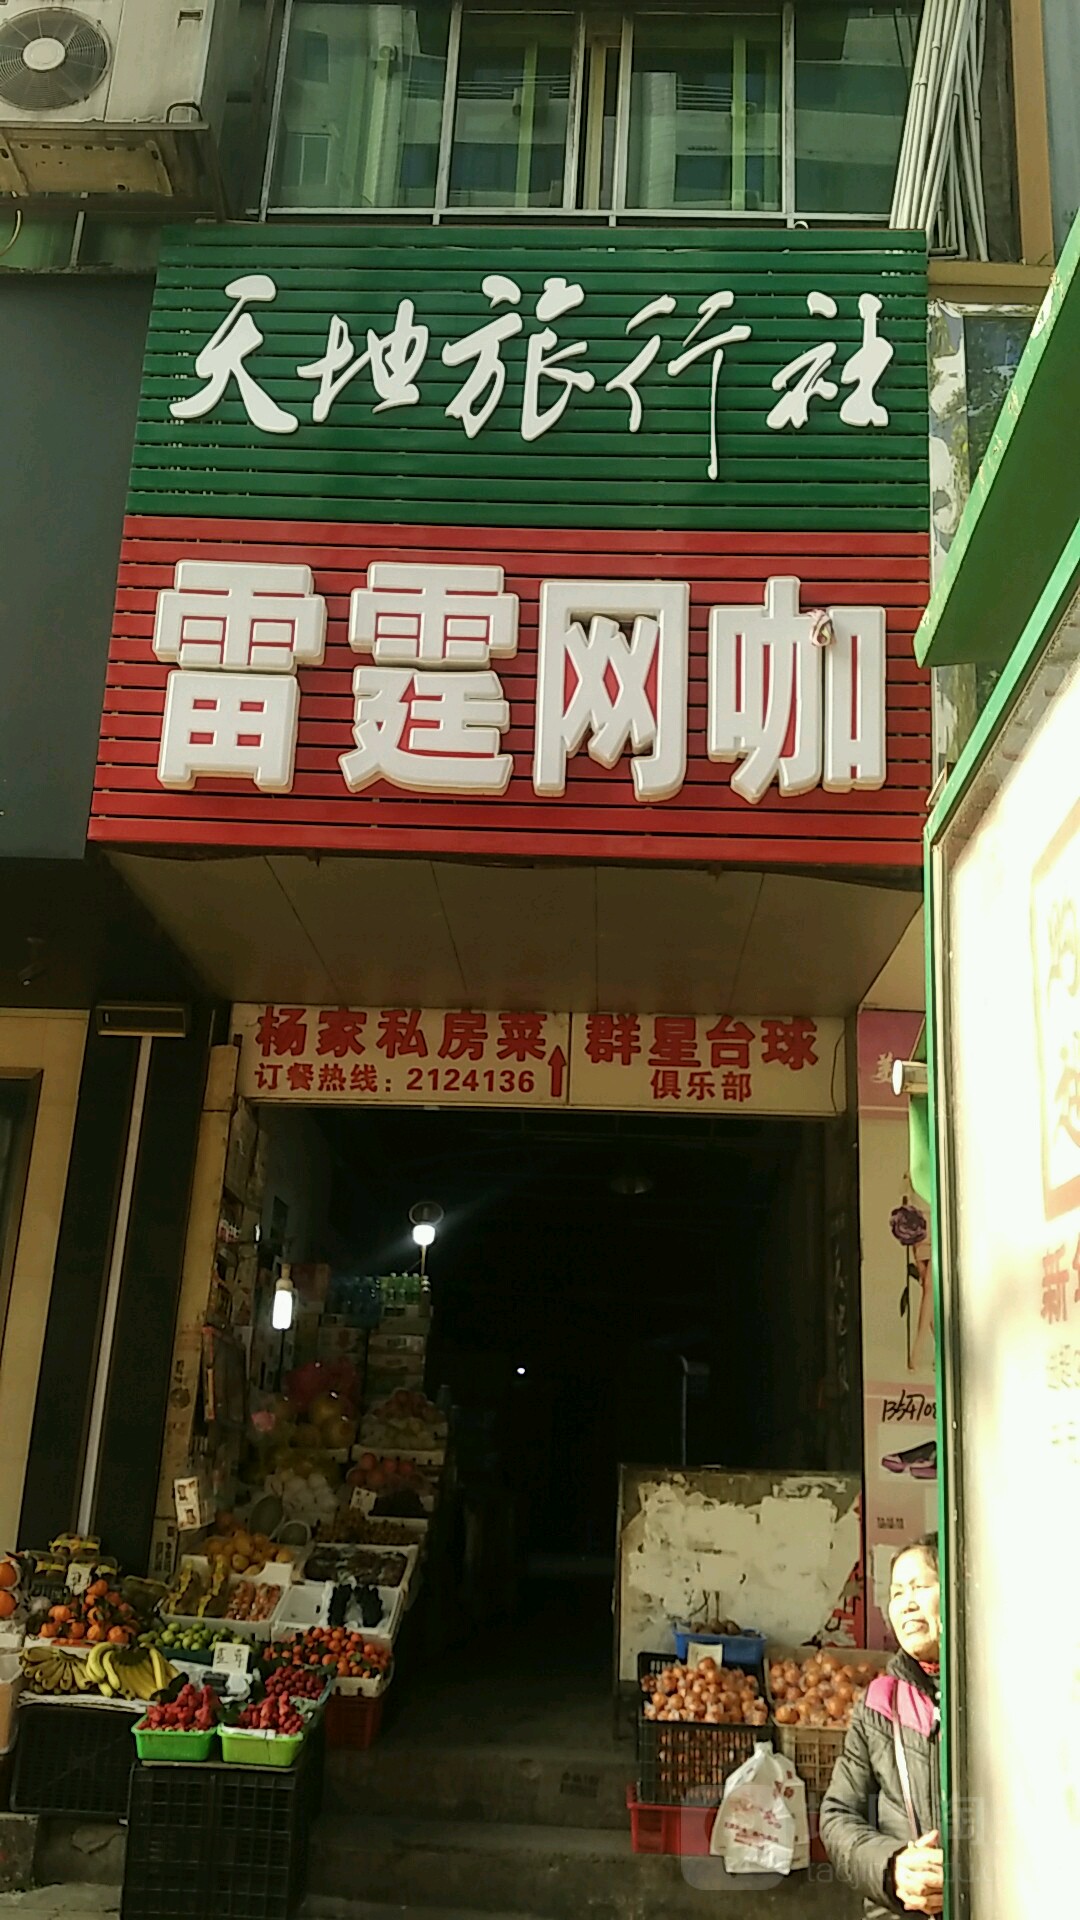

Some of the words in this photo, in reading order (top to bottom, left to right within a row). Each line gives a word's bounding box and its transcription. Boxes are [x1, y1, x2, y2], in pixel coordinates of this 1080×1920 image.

[169, 274, 893, 480] 天地旅行社
[152, 560, 886, 803] 雷霆网咖
[255, 1005, 548, 1063] 杨家私房菜
[585, 1013, 819, 1070] 群星台球
[650, 1070, 752, 1102] 俱乐部
